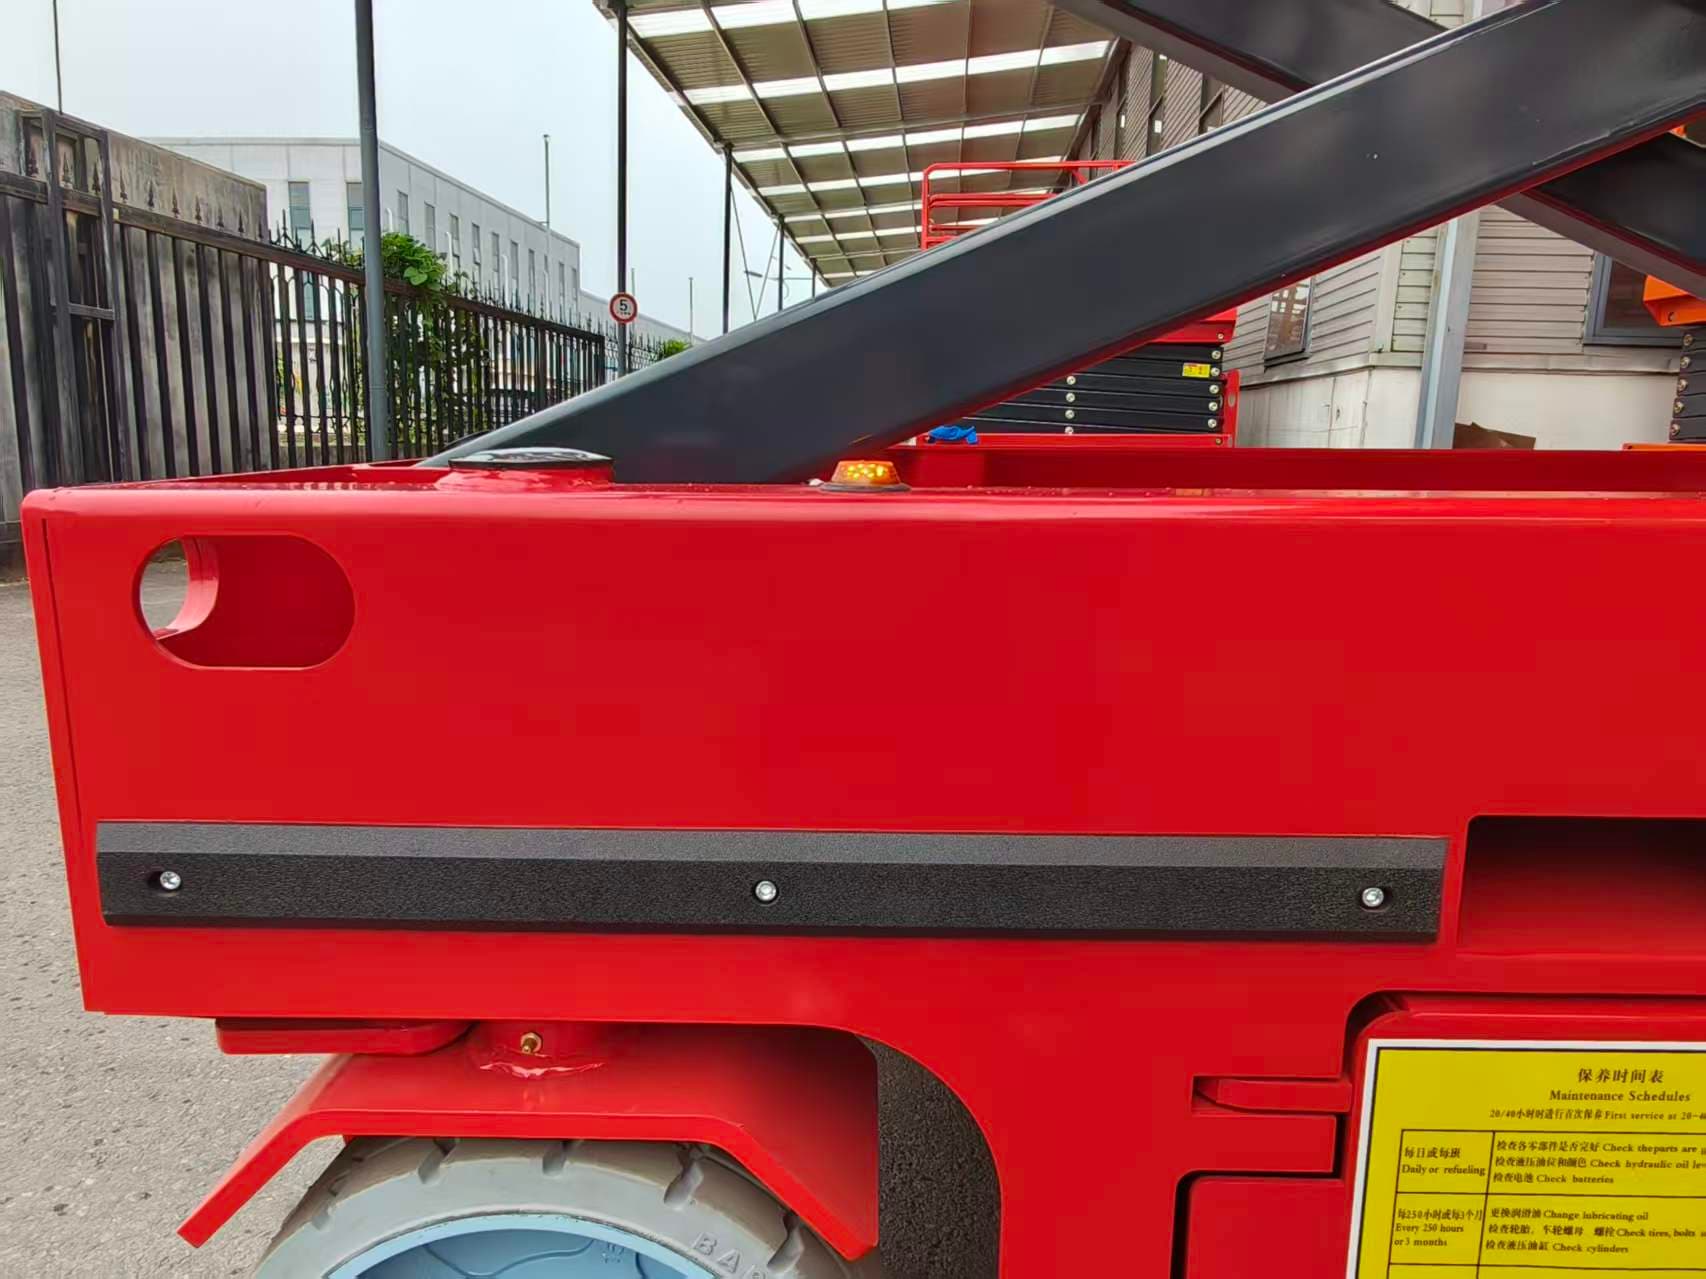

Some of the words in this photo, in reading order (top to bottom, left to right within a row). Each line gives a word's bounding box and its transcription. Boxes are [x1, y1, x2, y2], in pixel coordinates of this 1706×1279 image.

[620, 299, 628, 311] 5
[1578, 1068, 1664, 1084] 保养时间表
[1550, 1090, 1624, 1101] Maintenance
[1628, 1090, 1691, 1103] Schedules
[1631, 1110, 1665, 1120] service
[1404, 1147, 1461, 1159] 每日或每班
[1603, 1143, 1634, 1153] Check
[1401, 1164, 1426, 1176] Daily
[1443, 1165, 1486, 1177] refueling
[1590, 1158, 1621, 1169] Check
[1625, 1159, 1672, 1171] hydraulic
[1676, 1159, 1689, 1169] oil
[1493, 1172, 1533, 1184] 检查电池
[1536, 1174, 1567, 1183] Check
[1572, 1174, 1614, 1184] batteries
[1491, 1208, 1541, 1219] 更换润滑油
[1543, 1209, 1580, 1221] Change
[1583, 1211, 1634, 1222] lubricating
[1636, 1212, 1648, 1221] oil
[1396, 1223, 1420, 1235] Every
[1423, 1224, 1437, 1233] 250
[1440, 1225, 1464, 1233] hours
[1413, 1237, 1448, 1247] months
[1552, 1242, 1583, 1252] Check
[1586, 1244, 1629, 1254] cylinders
